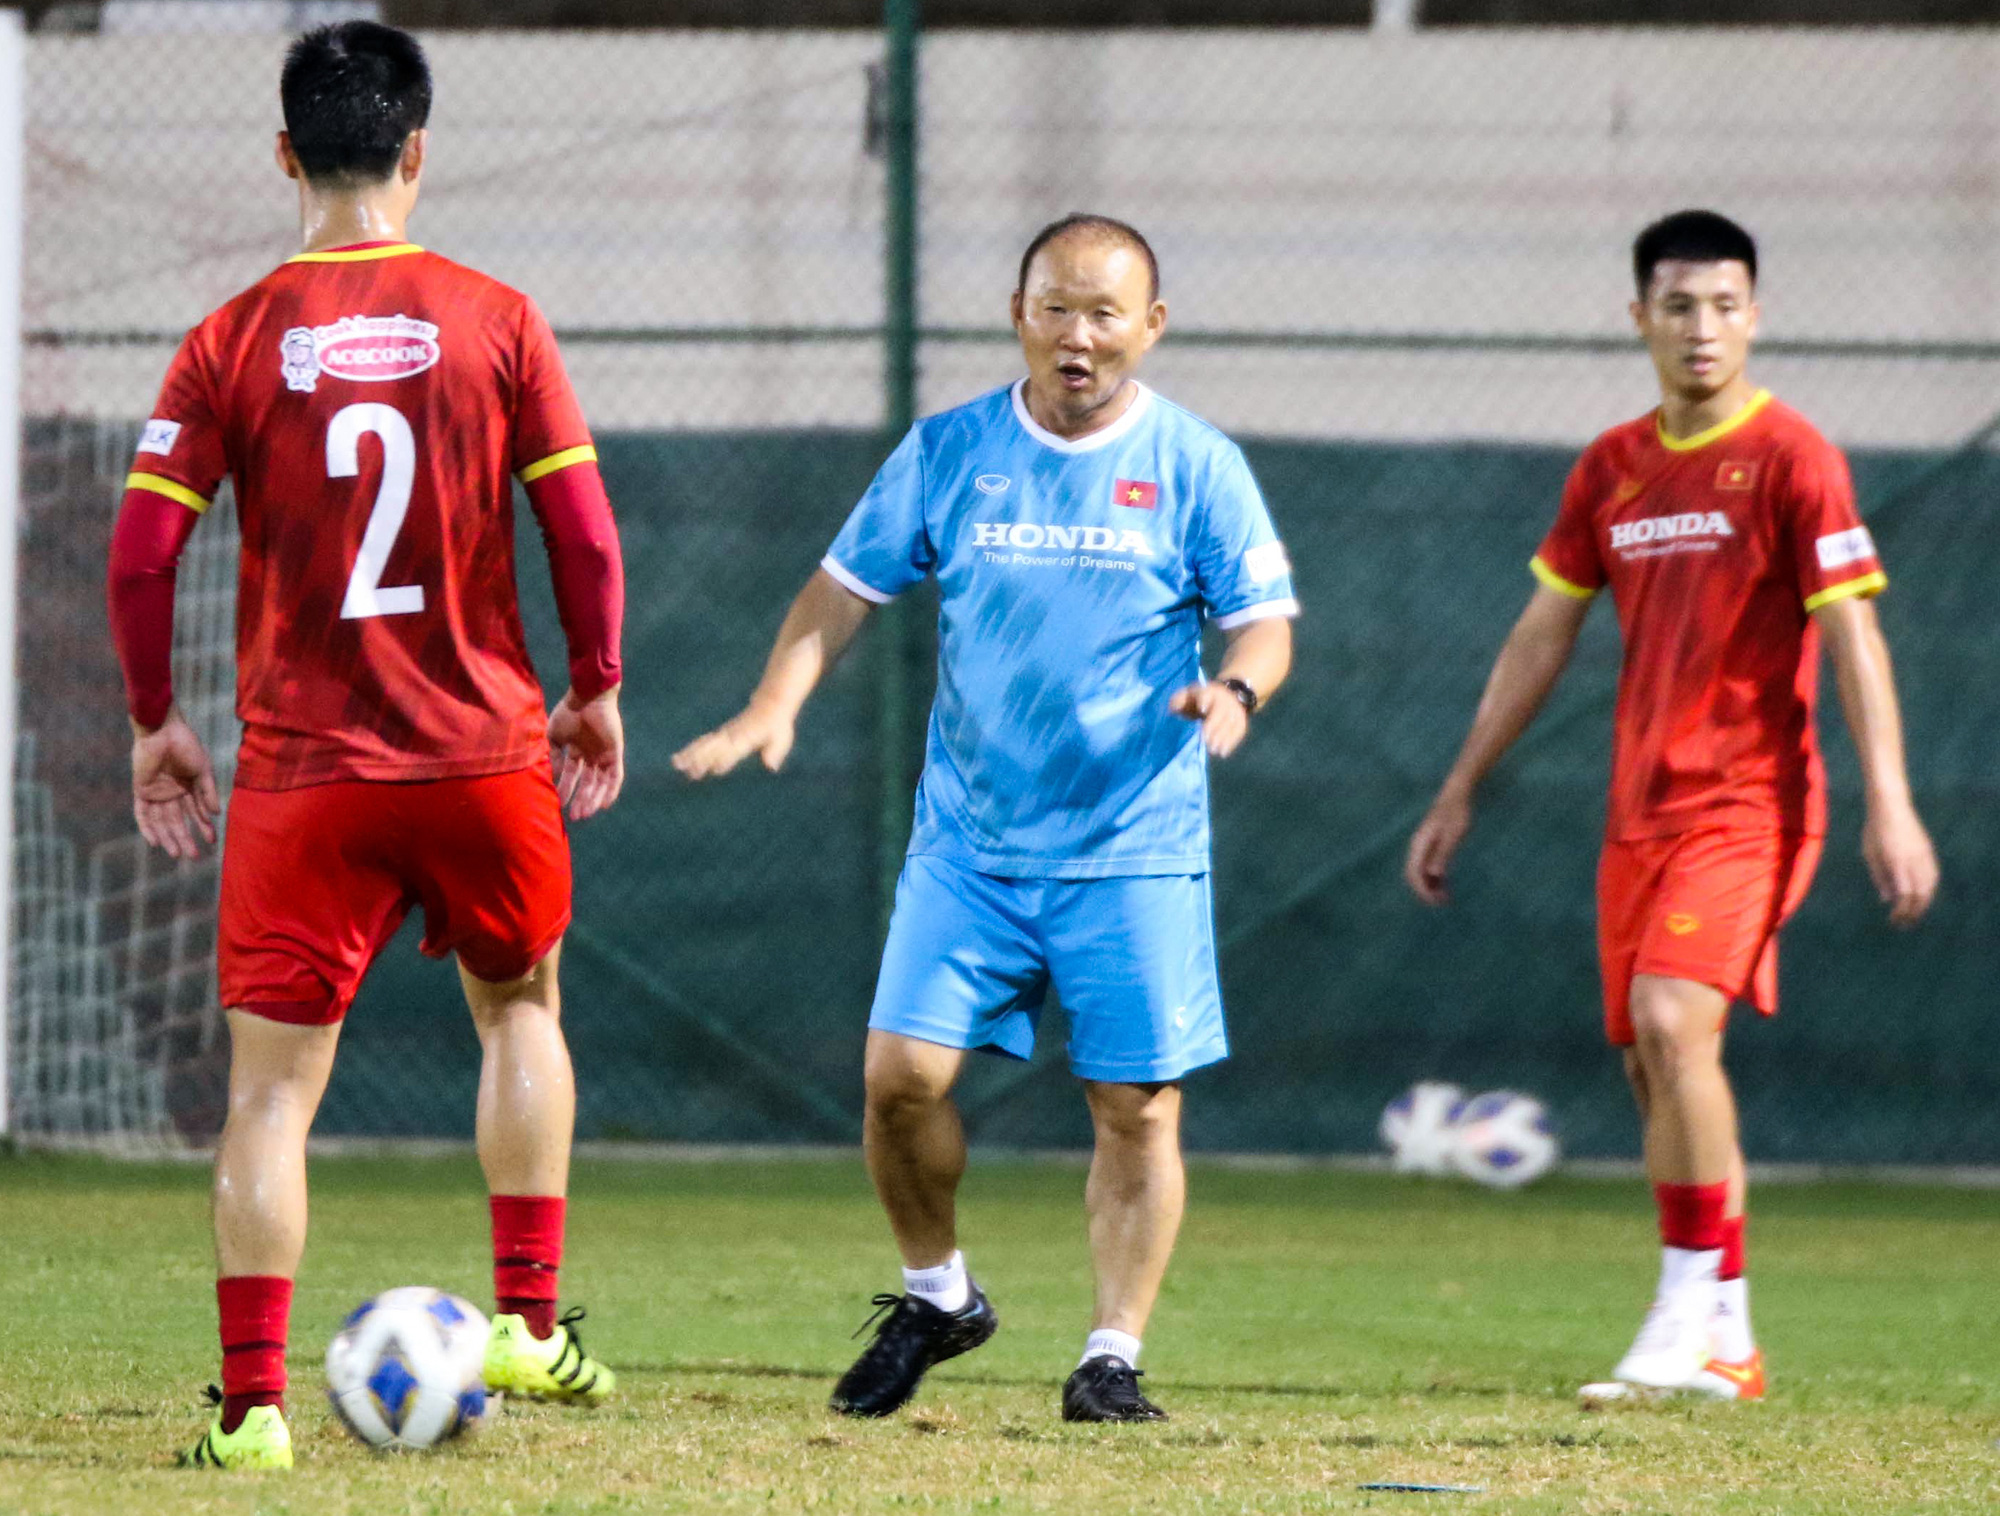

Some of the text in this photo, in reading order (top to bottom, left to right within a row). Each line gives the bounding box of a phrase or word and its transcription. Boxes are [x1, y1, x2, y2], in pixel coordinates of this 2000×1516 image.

[326, 402, 425, 620] 2
[971, 523, 1154, 557] HONDA
[1610, 510, 1734, 549] HONDA
[984, 551, 1136, 573] The Power of Dreams
